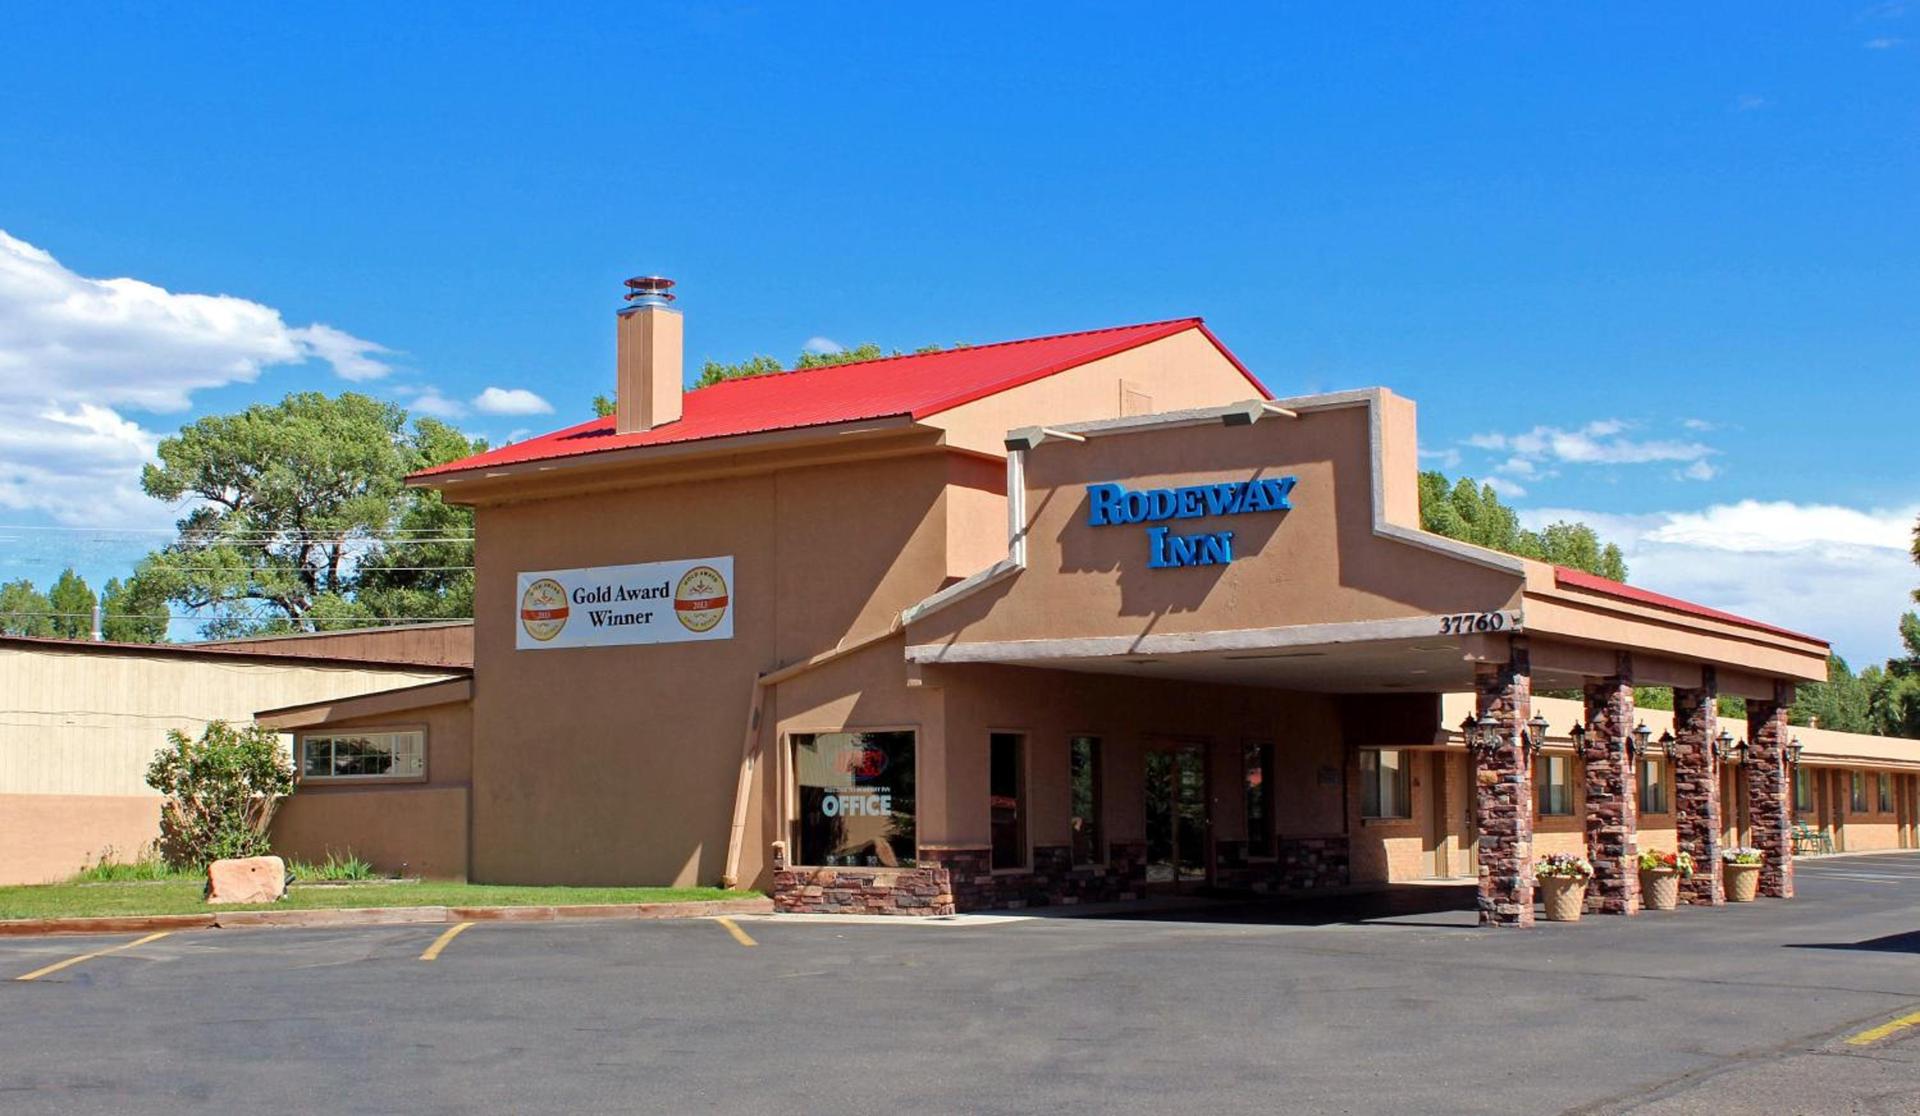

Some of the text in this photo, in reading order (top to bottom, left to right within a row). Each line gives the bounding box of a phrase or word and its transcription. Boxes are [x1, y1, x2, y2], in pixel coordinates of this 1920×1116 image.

[1086, 476, 1297, 527] RODEWAY
[1146, 526, 1233, 569] INN
[573, 581, 670, 605] Gold Award
[589, 609, 653, 629] Winner
[1439, 612, 1503, 634] 37760
[822, 794, 892, 817] OFFICE
